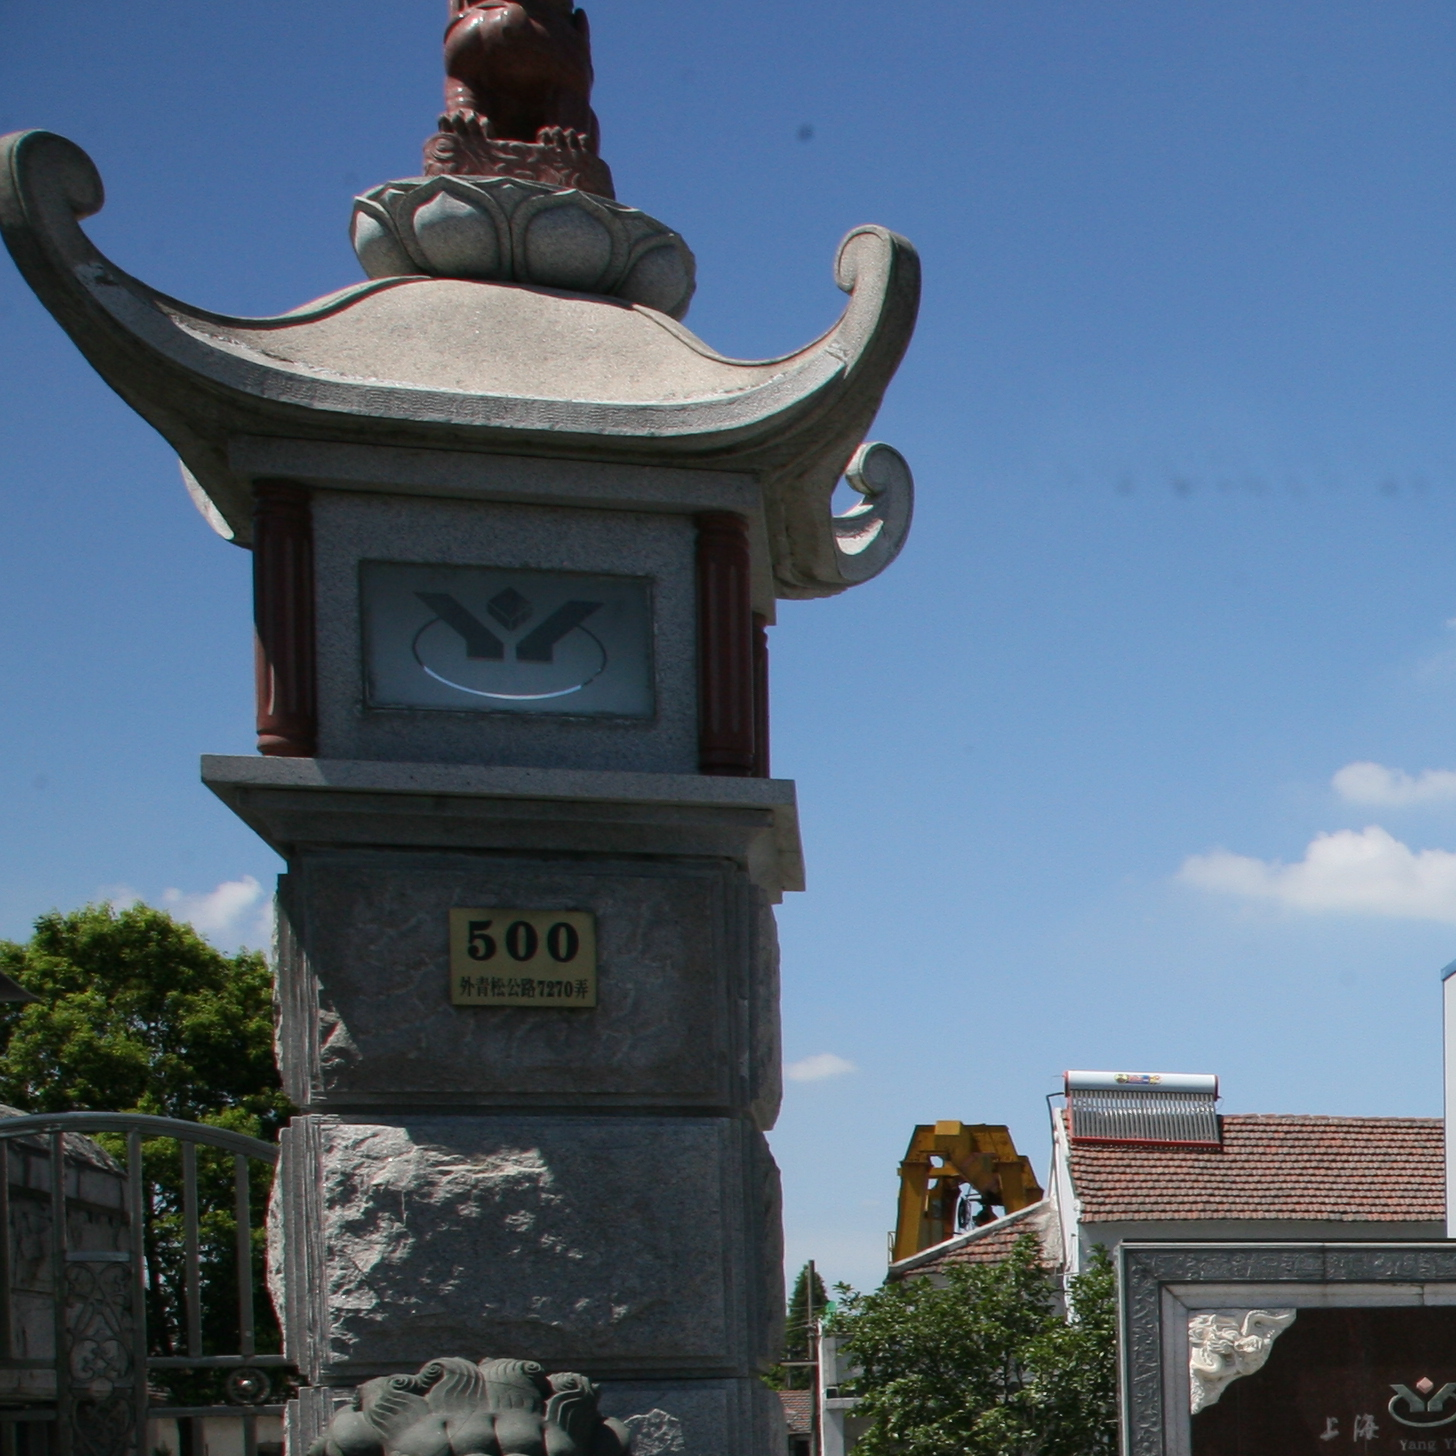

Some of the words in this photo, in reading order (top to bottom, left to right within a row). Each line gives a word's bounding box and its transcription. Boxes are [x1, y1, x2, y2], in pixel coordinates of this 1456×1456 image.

[467, 920, 579, 963] 500
[1319, 1413, 1380, 1443] 上海
[1399, 1438, 1437, 1452] Yang
